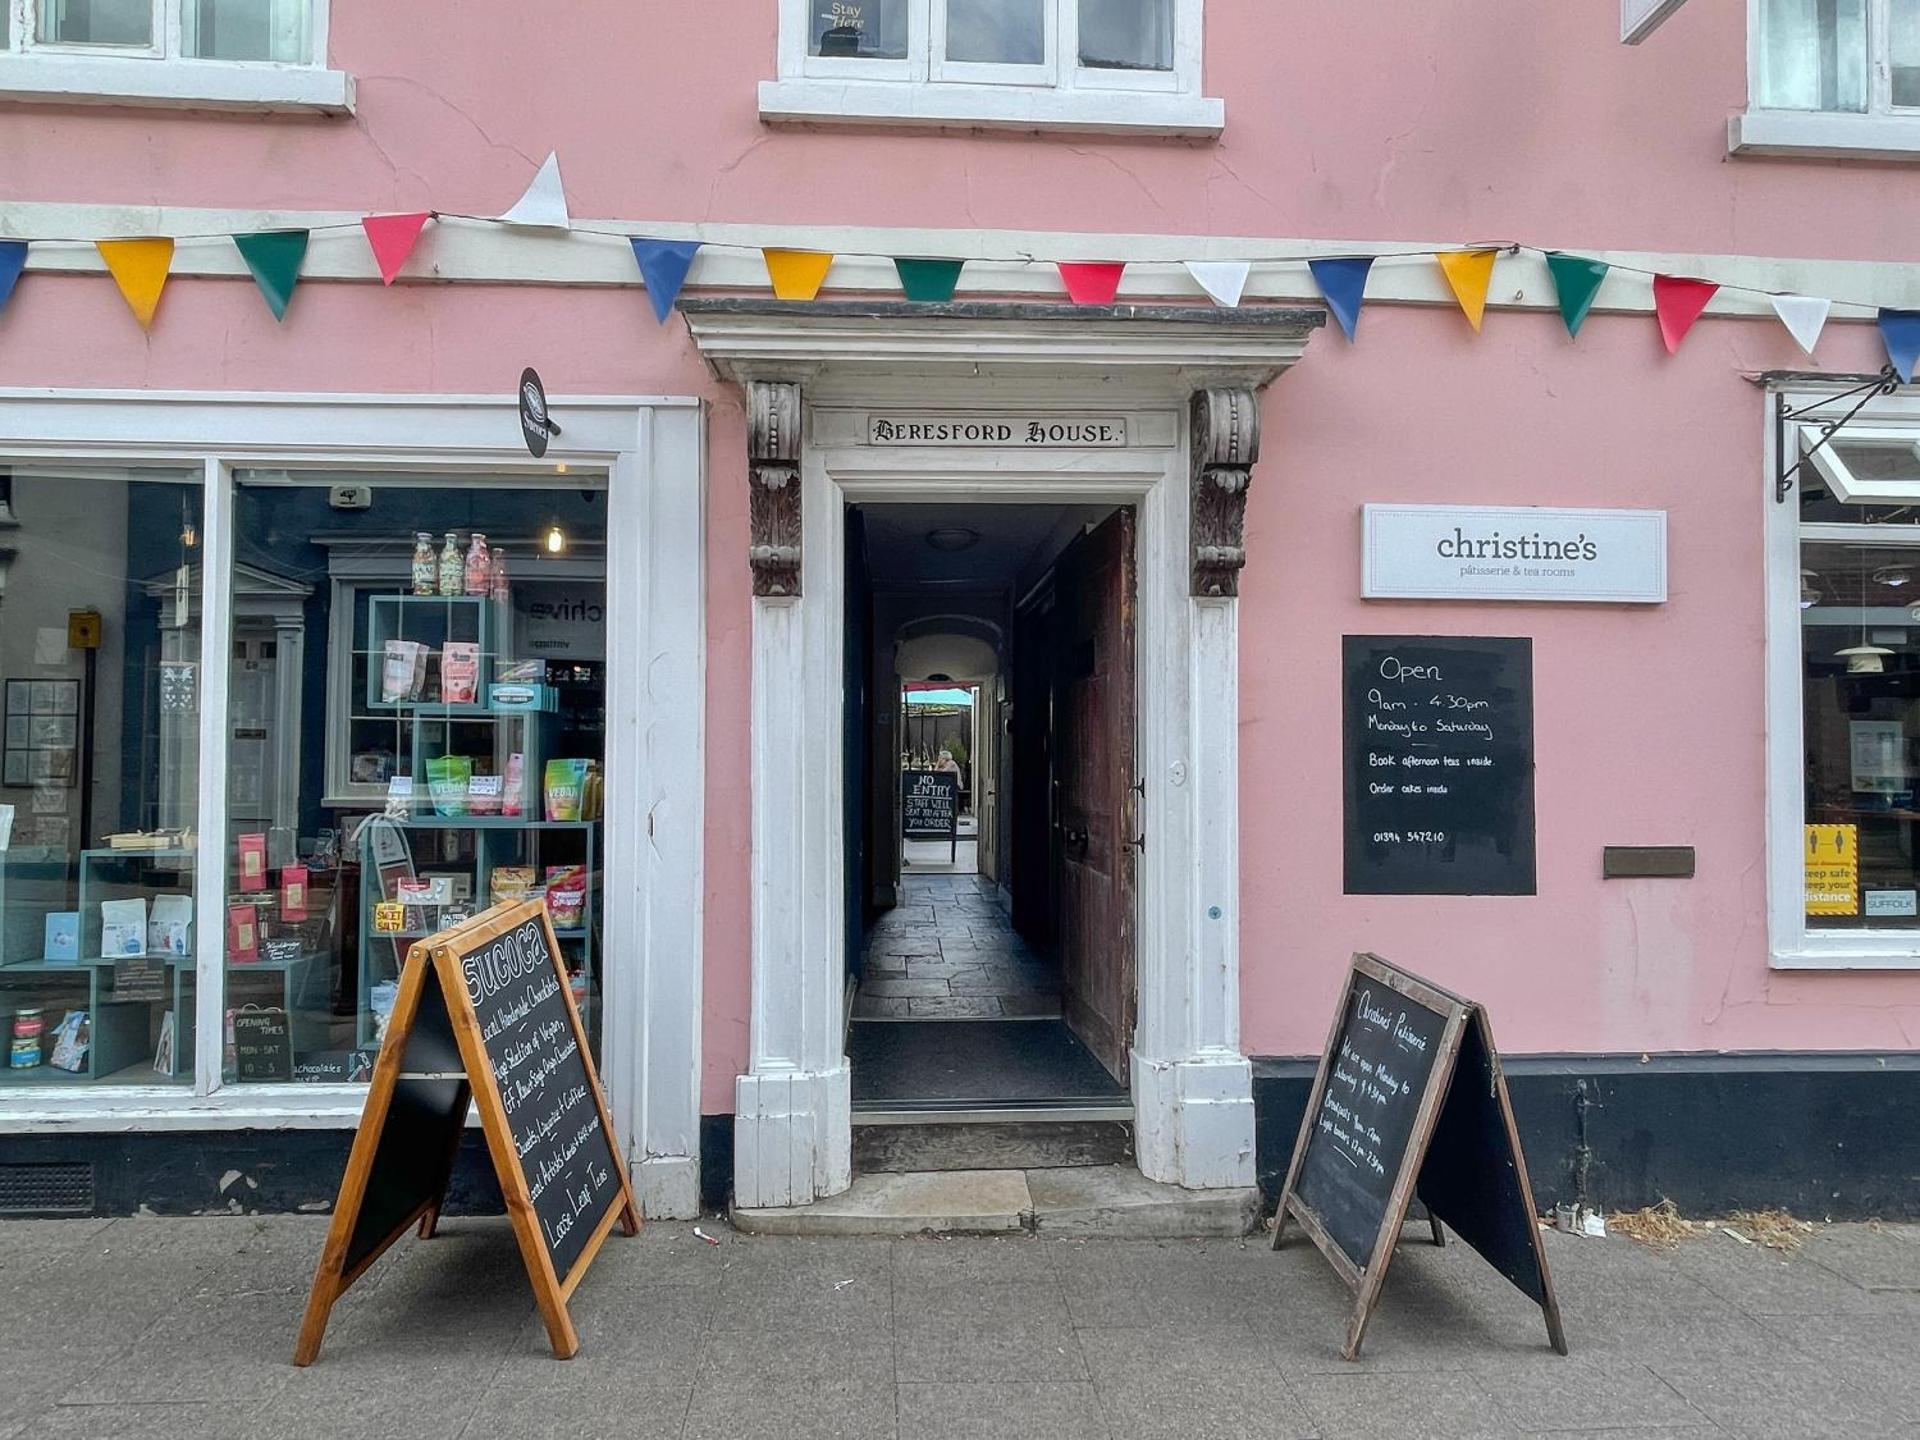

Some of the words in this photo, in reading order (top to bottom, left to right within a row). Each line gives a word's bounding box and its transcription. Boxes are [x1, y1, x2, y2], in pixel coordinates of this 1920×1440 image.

[832, 2, 861, 18] Stay
[831, 15, 865, 29] Here
[875, 419, 1012, 441] BERESFORD
[1437, 527, 1598, 561] christine's
[1459, 565, 1511, 578] pâtisserie
[1512, 566, 1522, 577] &
[1523, 566, 1540, 577] tea
[1541, 568, 1576, 578] rooms
[1380, 656, 1444, 683] Open
[1367, 688, 1407, 712] 9am
[1429, 694, 1489, 713] 4.30pm
[1368, 713, 1412, 739] Monday
[1436, 718, 1494, 741] Saturday
[1369, 752, 1397, 767] Book
[1402, 755, 1440, 768] afternoon
[1443, 755, 1460, 767] teas
[918, 775, 934, 786] NO
[548, 786, 578, 798] VEGAN
[913, 784, 951, 797] ENTRY
[1369, 782, 1395, 794] Order
[1401, 784, 1422, 794] cakes
[1426, 784, 1449, 794] inside
[907, 798, 928, 809] STAFF
[931, 798, 951, 810] WILL
[924, 818, 951, 829] ORDER
[1374, 832, 1401, 843] 01394
[1407, 831, 1445, 843] 547210
[1830, 867, 1851, 878] safe
[1828, 882, 1851, 892] your
[526, 974, 560, 1008] Chocolates
[236, 1017, 271, 1028] OPENING
[260, 1025, 284, 1035] TIMES
[1375, 1063, 1399, 1096] Monday
[1401, 1080, 1410, 1095] to
[563, 1085, 587, 1110] Coffee
[543, 1213, 575, 1249] Loose
[566, 1184, 593, 1218] Leaf
[586, 1161, 608, 1191] Teas
